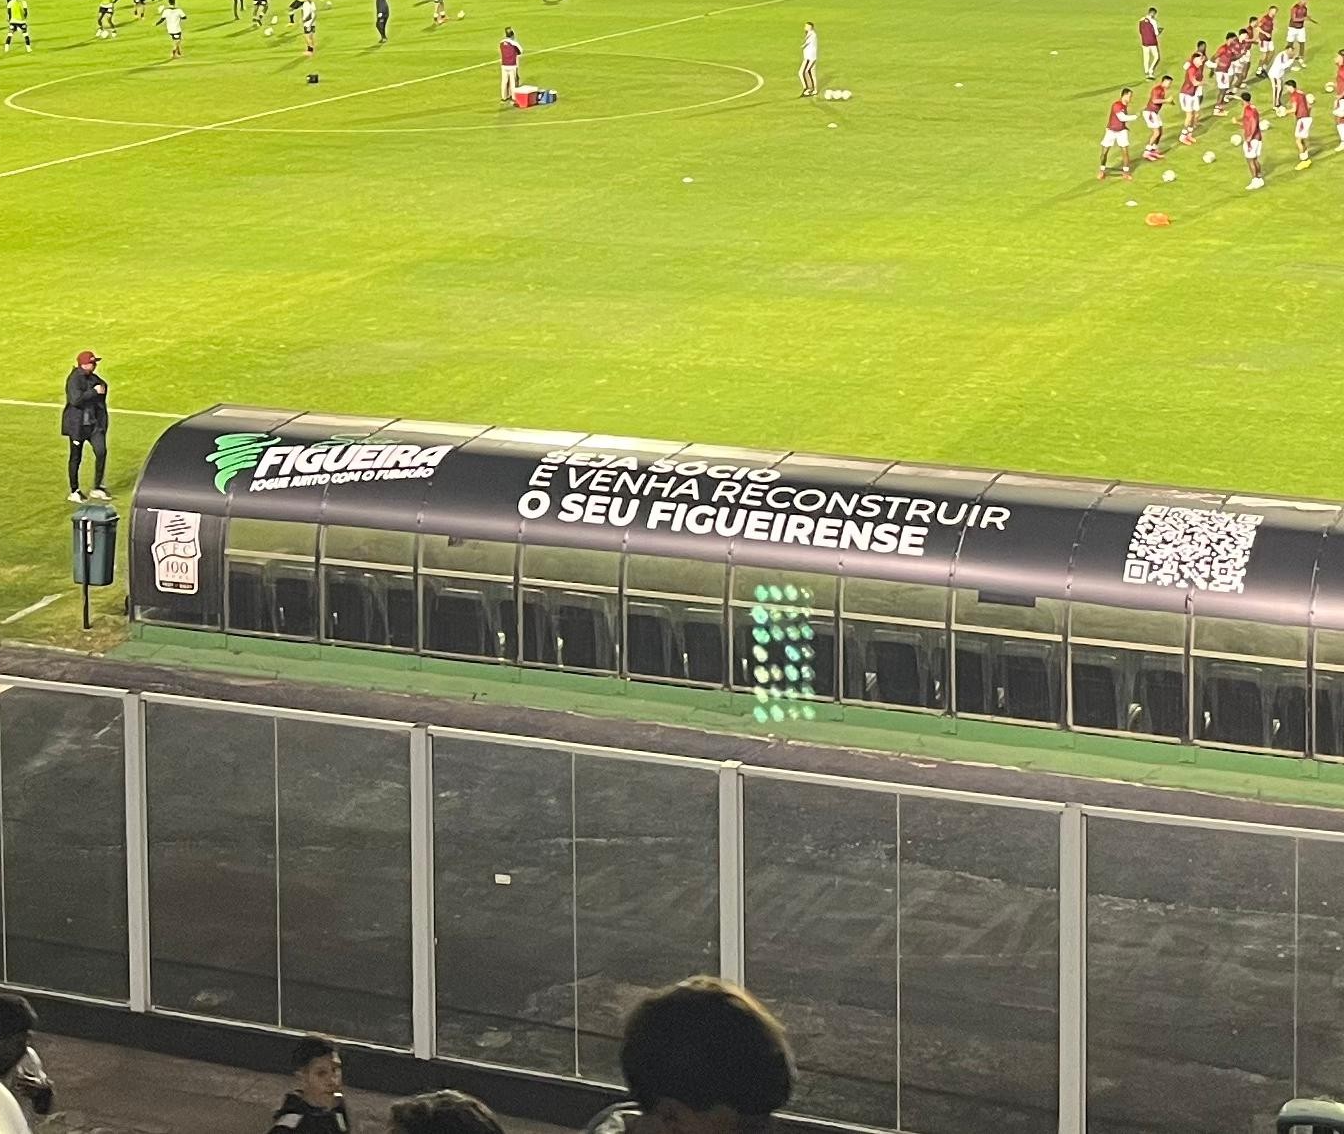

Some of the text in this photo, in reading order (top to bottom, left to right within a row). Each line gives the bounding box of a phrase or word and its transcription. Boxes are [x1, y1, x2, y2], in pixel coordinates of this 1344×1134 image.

[253, 445, 455, 478] FIGUEIRA
[331, 468, 362, 485] COM
[361, 468, 373, 482] O
[541, 449, 781, 483] SEJA SÓCIO
[529, 464, 1012, 531] E VENHA RECONSTRUIR
[517, 490, 929, 557] O SEU FIGUEIRENSE
[166, 560, 189, 574] 100
